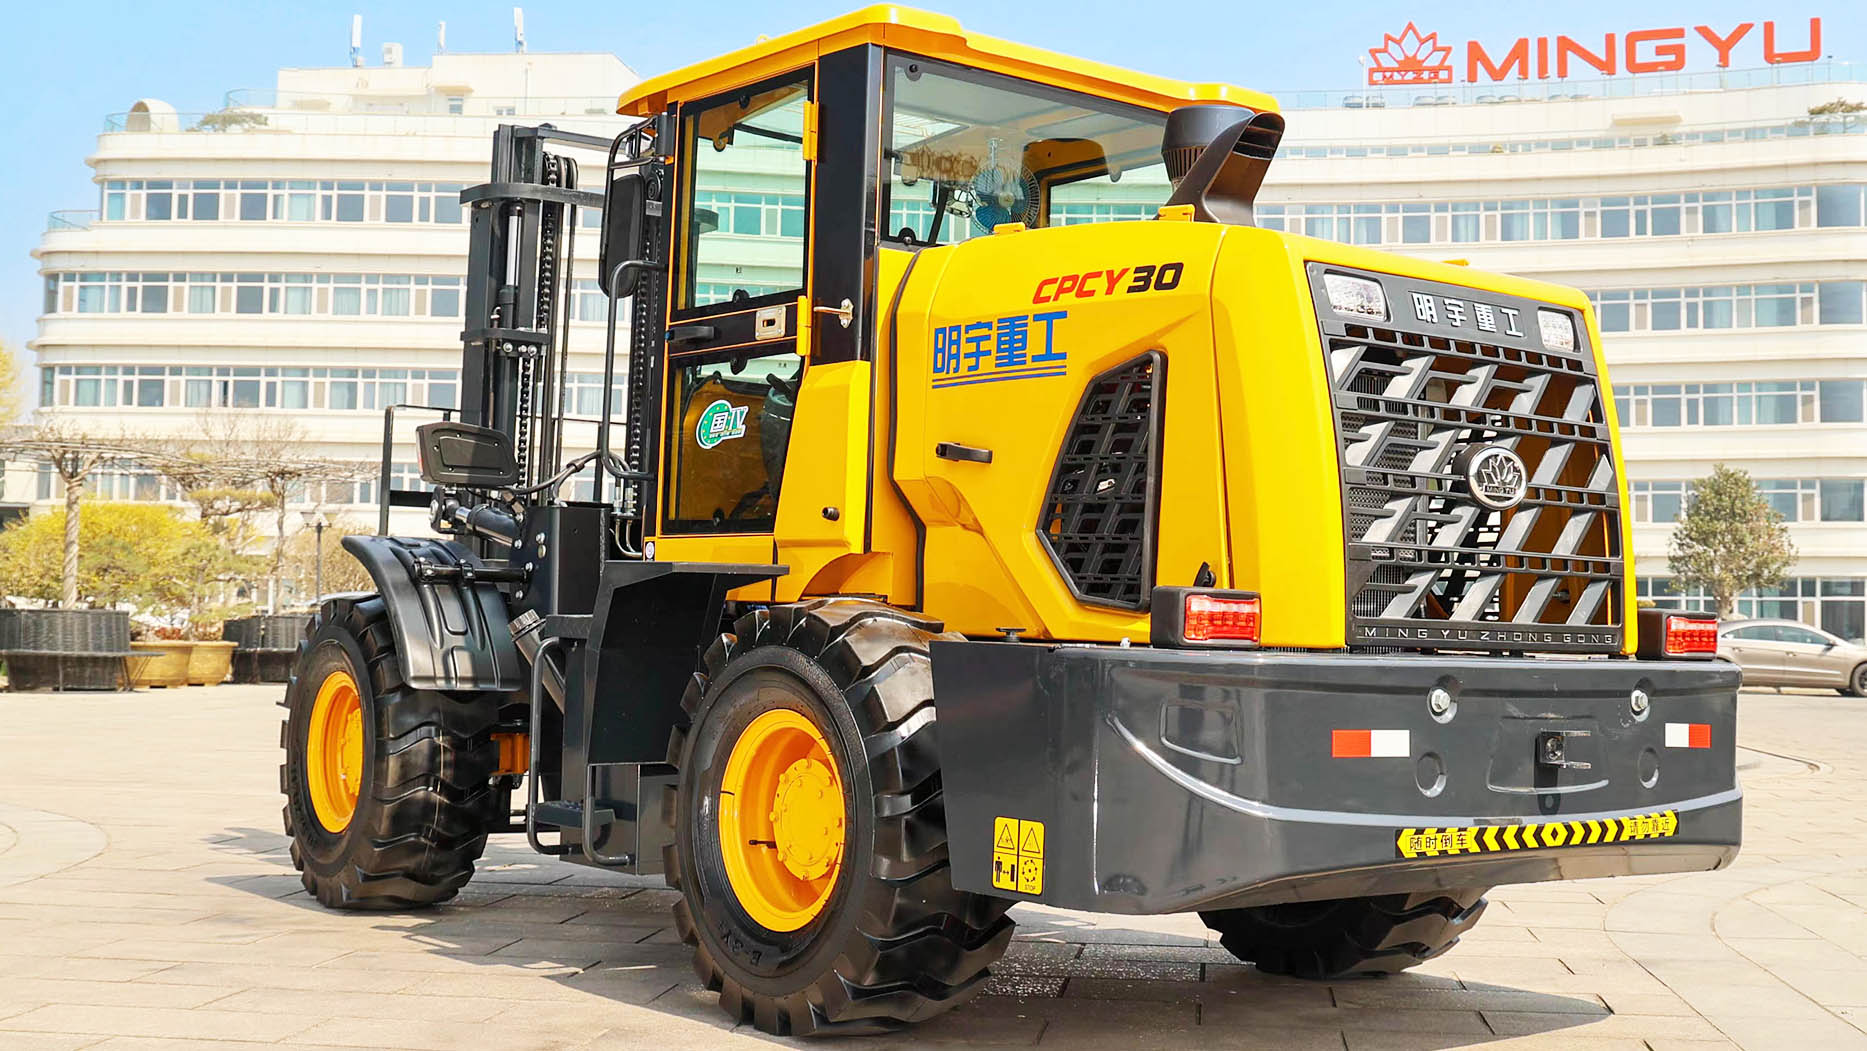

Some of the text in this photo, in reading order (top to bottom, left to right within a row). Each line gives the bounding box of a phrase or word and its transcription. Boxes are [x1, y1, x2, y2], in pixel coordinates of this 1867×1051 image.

[1467, 17, 1821, 82] MINGYU
[1032, 262, 1184, 304] CPCY30
[1412, 292, 1523, 337] 明宇重工
[933, 311, 1067, 374] 明宇重工
[1364, 627, 1612, 645] MING YU ZHONG GONG
[1410, 832, 1468, 850] 随时倒车
